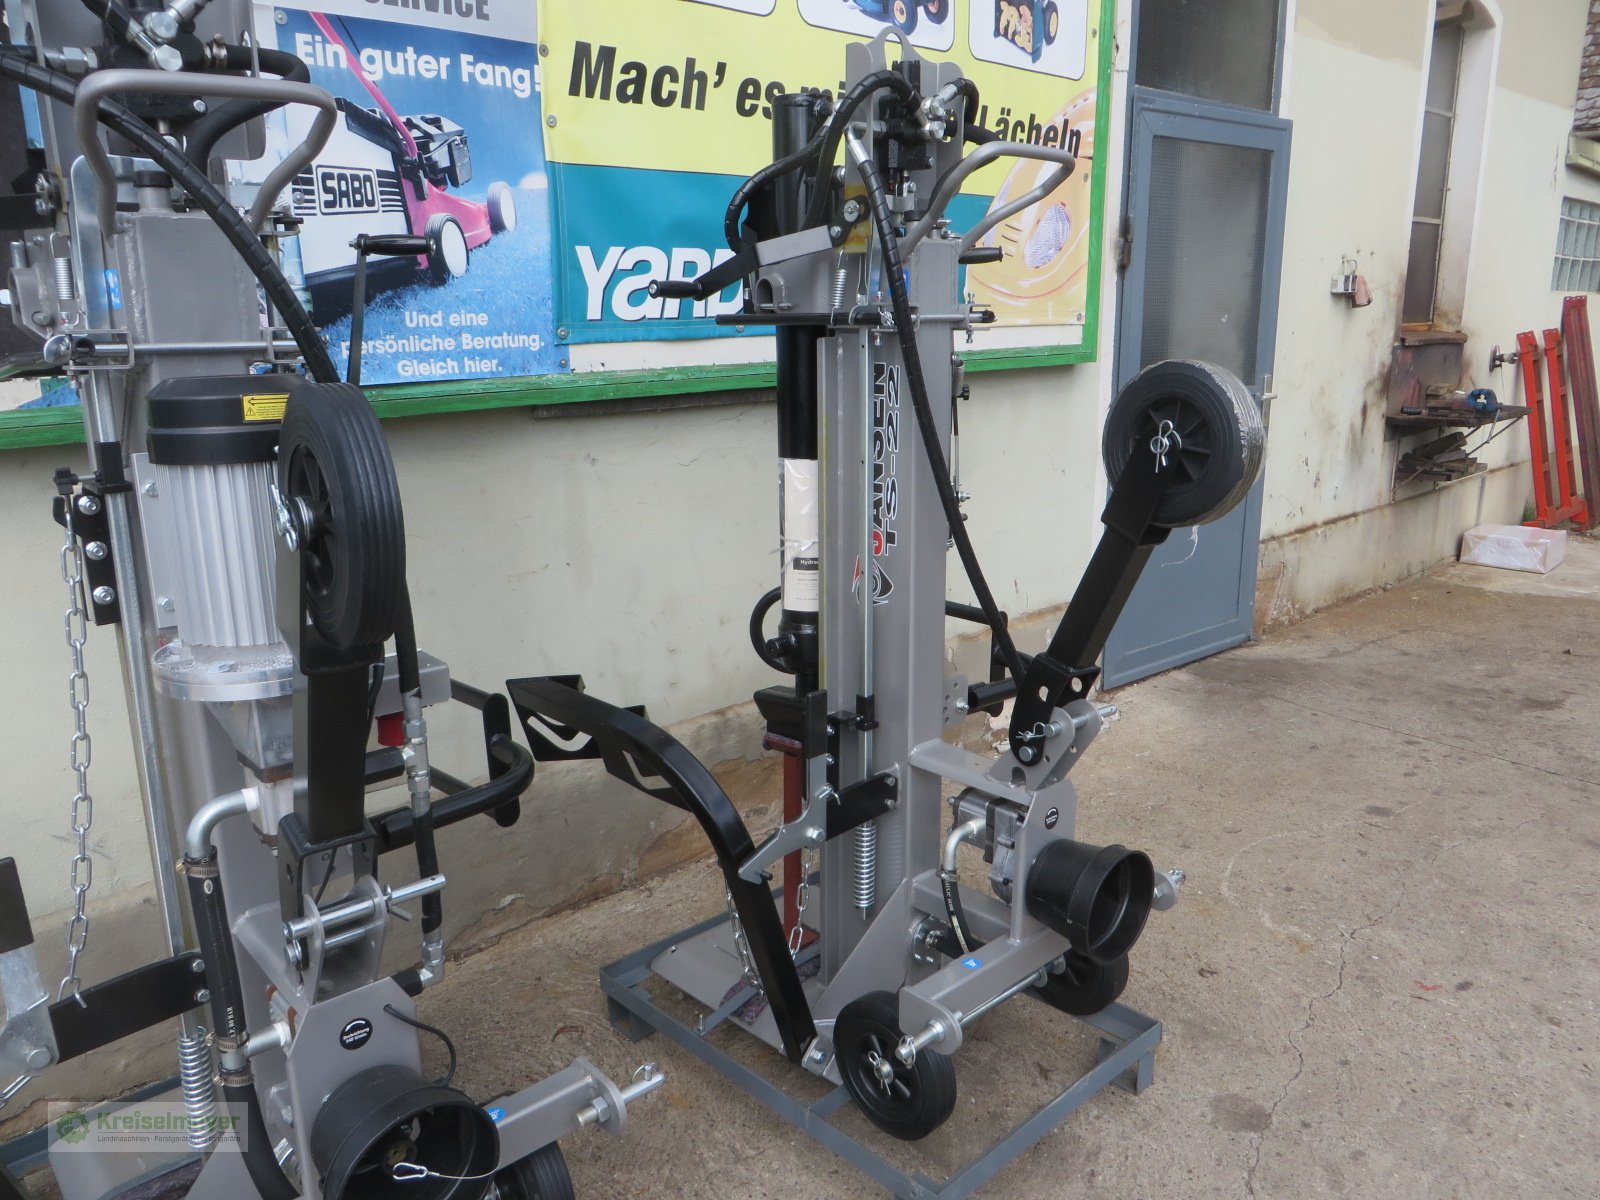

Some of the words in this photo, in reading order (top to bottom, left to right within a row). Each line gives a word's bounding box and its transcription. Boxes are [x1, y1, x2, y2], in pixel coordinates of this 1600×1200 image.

[295, 33, 347, 68] Ein
[360, 46, 450, 81] guter
[460, 53, 541, 99] Fang!
[568, 41, 727, 111] Mach'
[321, 172, 376, 208] SABO
[405, 311, 443, 328] Und
[449, 310, 489, 326] eine
[462, 332, 545, 351] Beratung.
[397, 359, 460, 376] Gleich
[464, 357, 503, 374] hier.
[872, 362, 887, 556] JANSEN
[884, 365, 900, 556] TS-22
